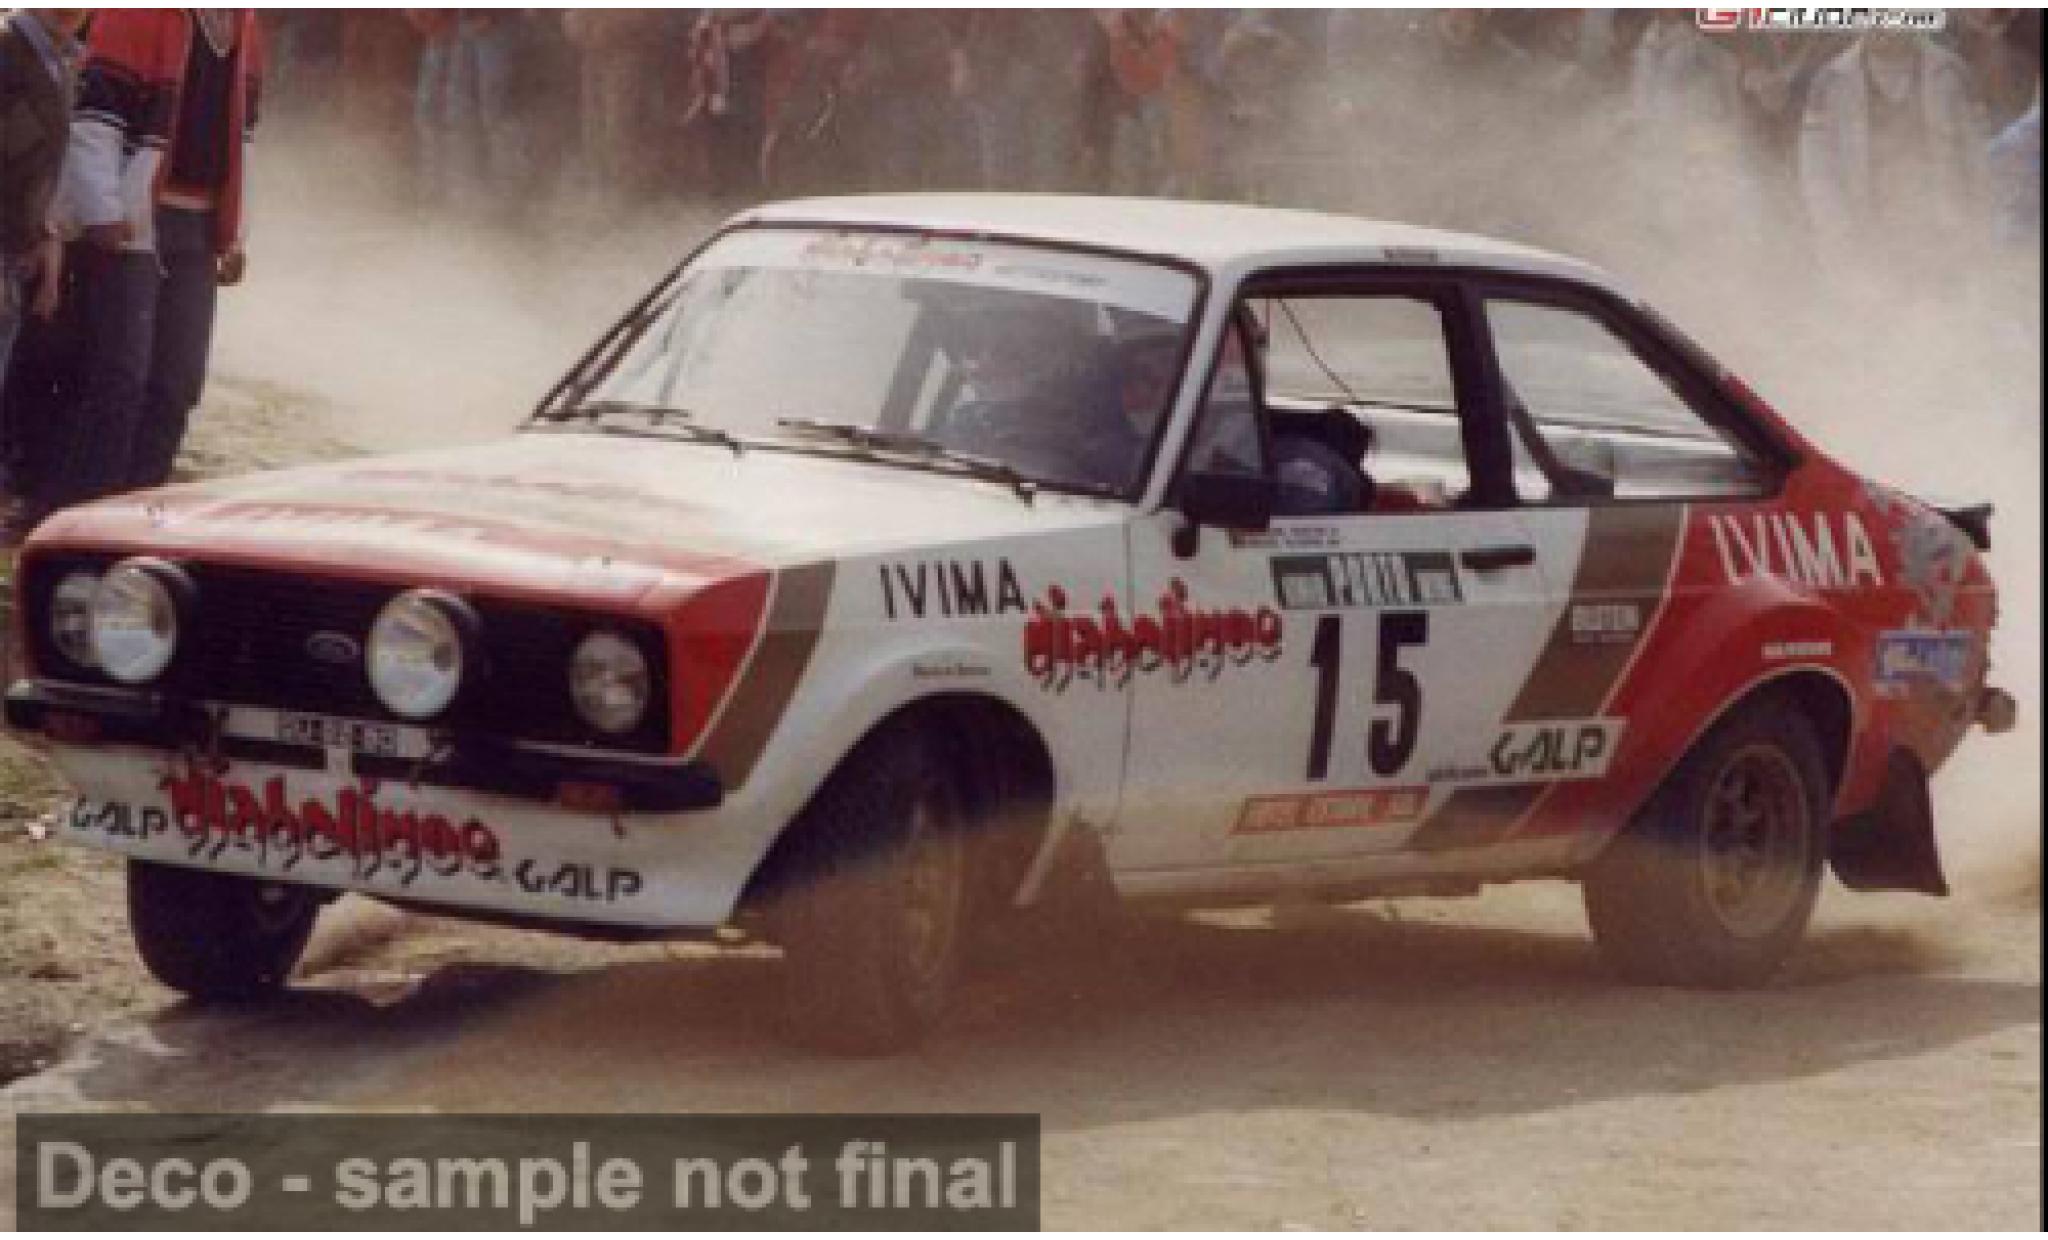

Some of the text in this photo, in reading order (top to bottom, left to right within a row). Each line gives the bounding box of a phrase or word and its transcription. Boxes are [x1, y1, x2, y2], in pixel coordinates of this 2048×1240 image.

[1708, 510, 1884, 588] IVIMA
[880, 557, 1026, 620] IVIMA
[1306, 610, 1430, 780] 15
[1490, 726, 1606, 776] GALP
[68, 794, 170, 840] GALP
[516, 860, 644, 902] GALP
